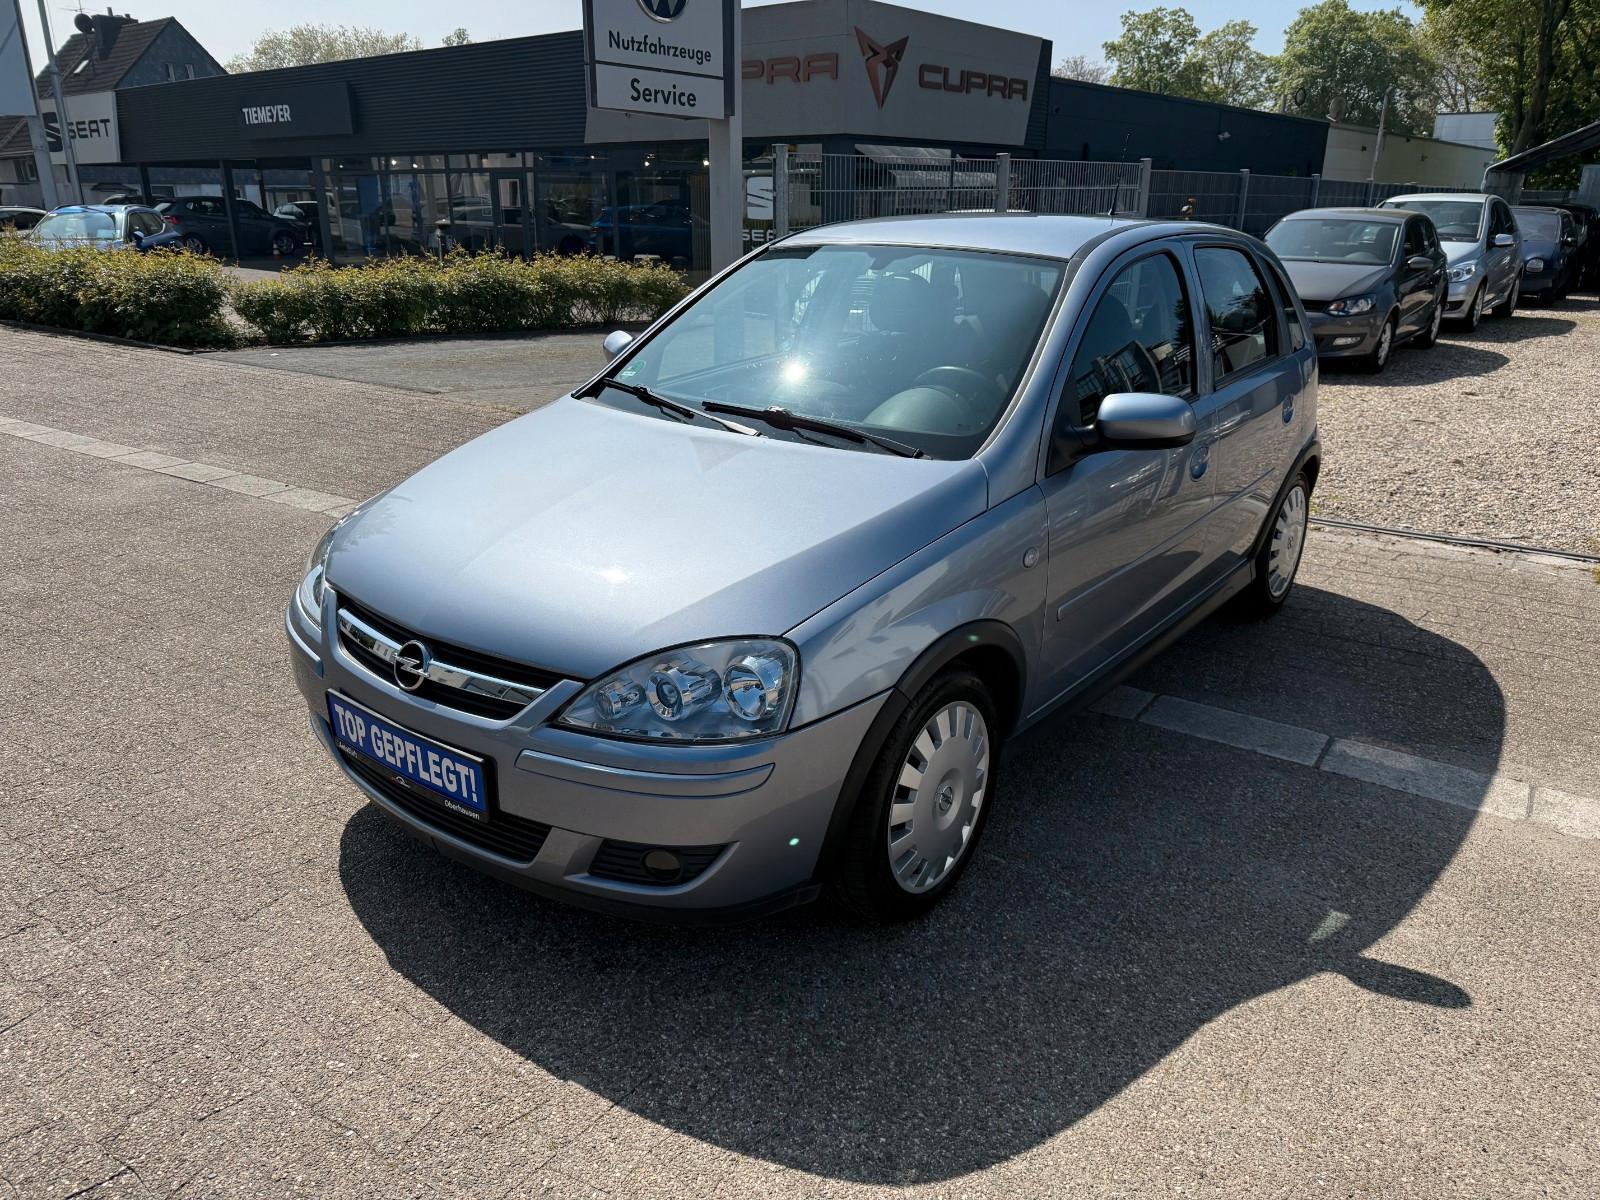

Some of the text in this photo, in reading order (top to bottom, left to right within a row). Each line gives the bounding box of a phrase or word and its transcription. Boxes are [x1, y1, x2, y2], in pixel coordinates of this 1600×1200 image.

[608, 30, 712, 65] Nutzfahrzeuge
[741, 52, 839, 85] PRA
[918, 64, 1029, 101] CUPRA
[630, 78, 697, 107] Service
[66, 118, 111, 139] SEAT
[241, 104, 292, 125] TIEMEYER
[742, 229, 775, 241] SEA
[334, 703, 478, 803] TOP GEPFLEGT!
[444, 799, 480, 821] Oberhausen
